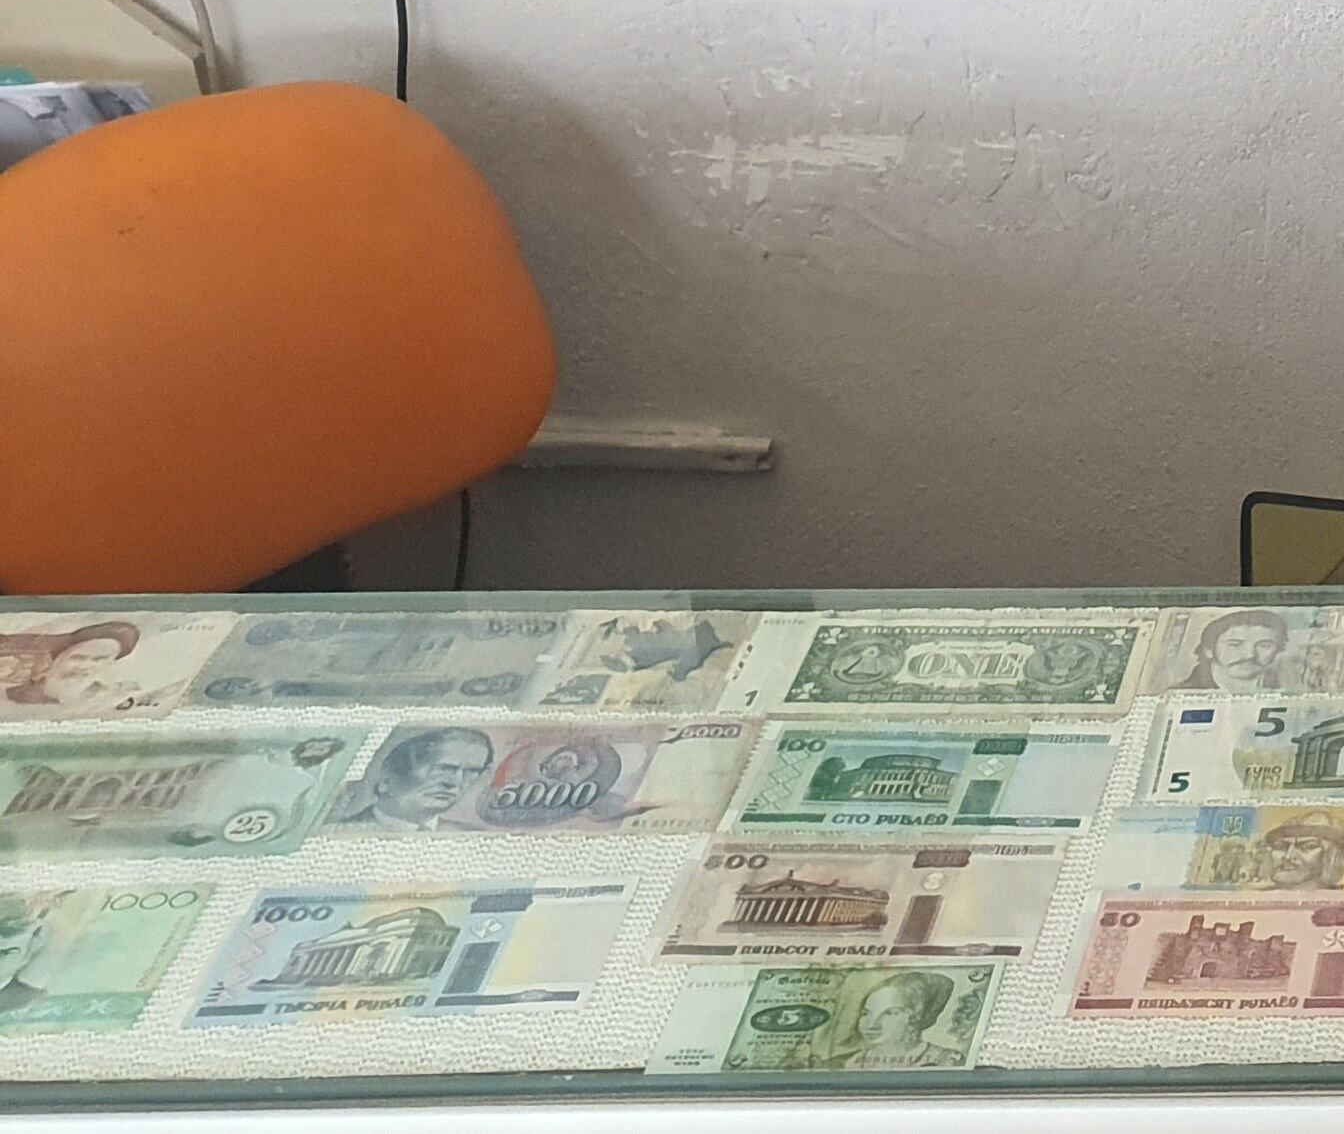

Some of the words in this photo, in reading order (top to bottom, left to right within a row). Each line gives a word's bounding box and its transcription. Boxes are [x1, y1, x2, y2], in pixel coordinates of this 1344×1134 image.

[906, 649, 1028, 679] ONE
[744, 689, 759, 707] 1
[1253, 706, 1288, 737] 5
[777, 738, 826, 752] 100
[1168, 771, 1191, 793] 5
[490, 780, 600, 809] 5000
[230, 815, 269, 835] 25
[831, 813, 871, 826] СТО
[704, 854, 770, 870] 500
[101, 890, 199, 911] 1000
[252, 904, 335, 924] 1000
[1099, 912, 1141, 928] 50
